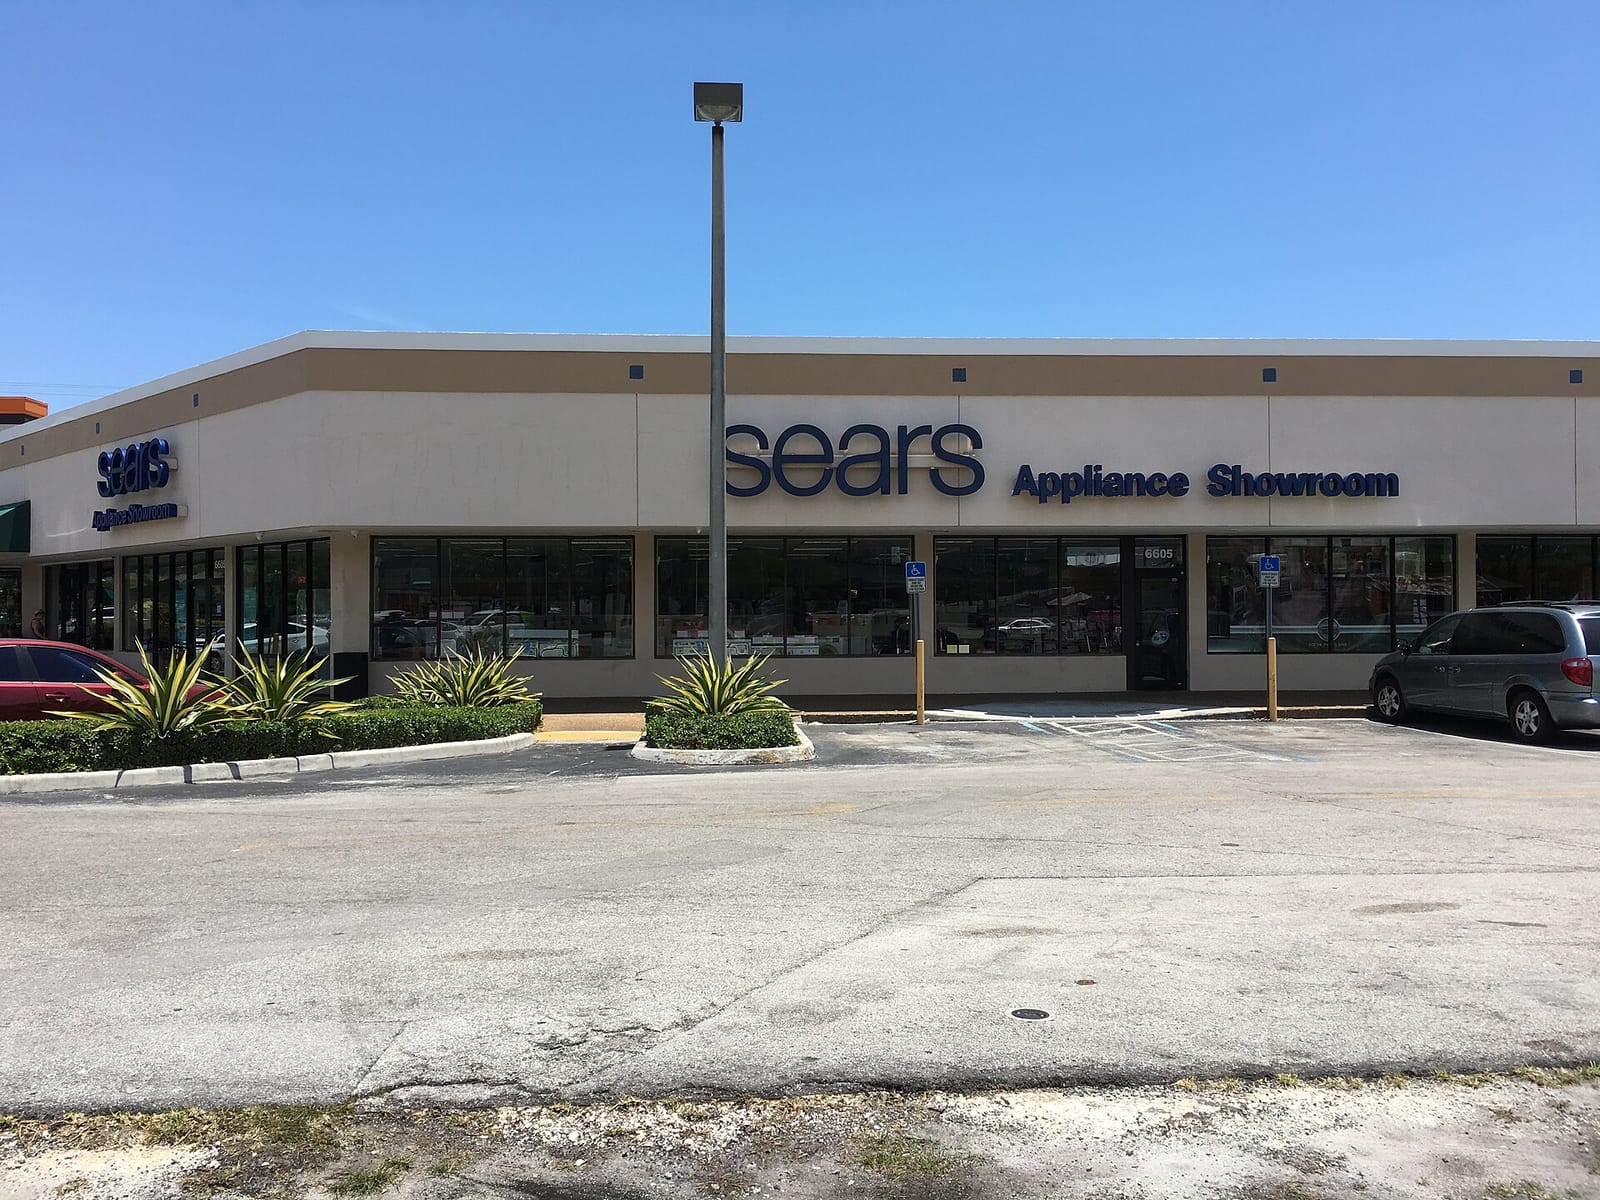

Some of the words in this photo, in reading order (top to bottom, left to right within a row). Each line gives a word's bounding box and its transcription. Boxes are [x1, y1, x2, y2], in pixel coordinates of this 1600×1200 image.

[97, 438, 170, 498] sears
[725, 423, 986, 497] sears
[1012, 464, 1190, 504] Appliance
[1207, 463, 1400, 497] Showroom
[92, 508, 127, 531] Appliance
[127, 503, 178, 525] Showroom
[1144, 548, 1174, 559] 6605
